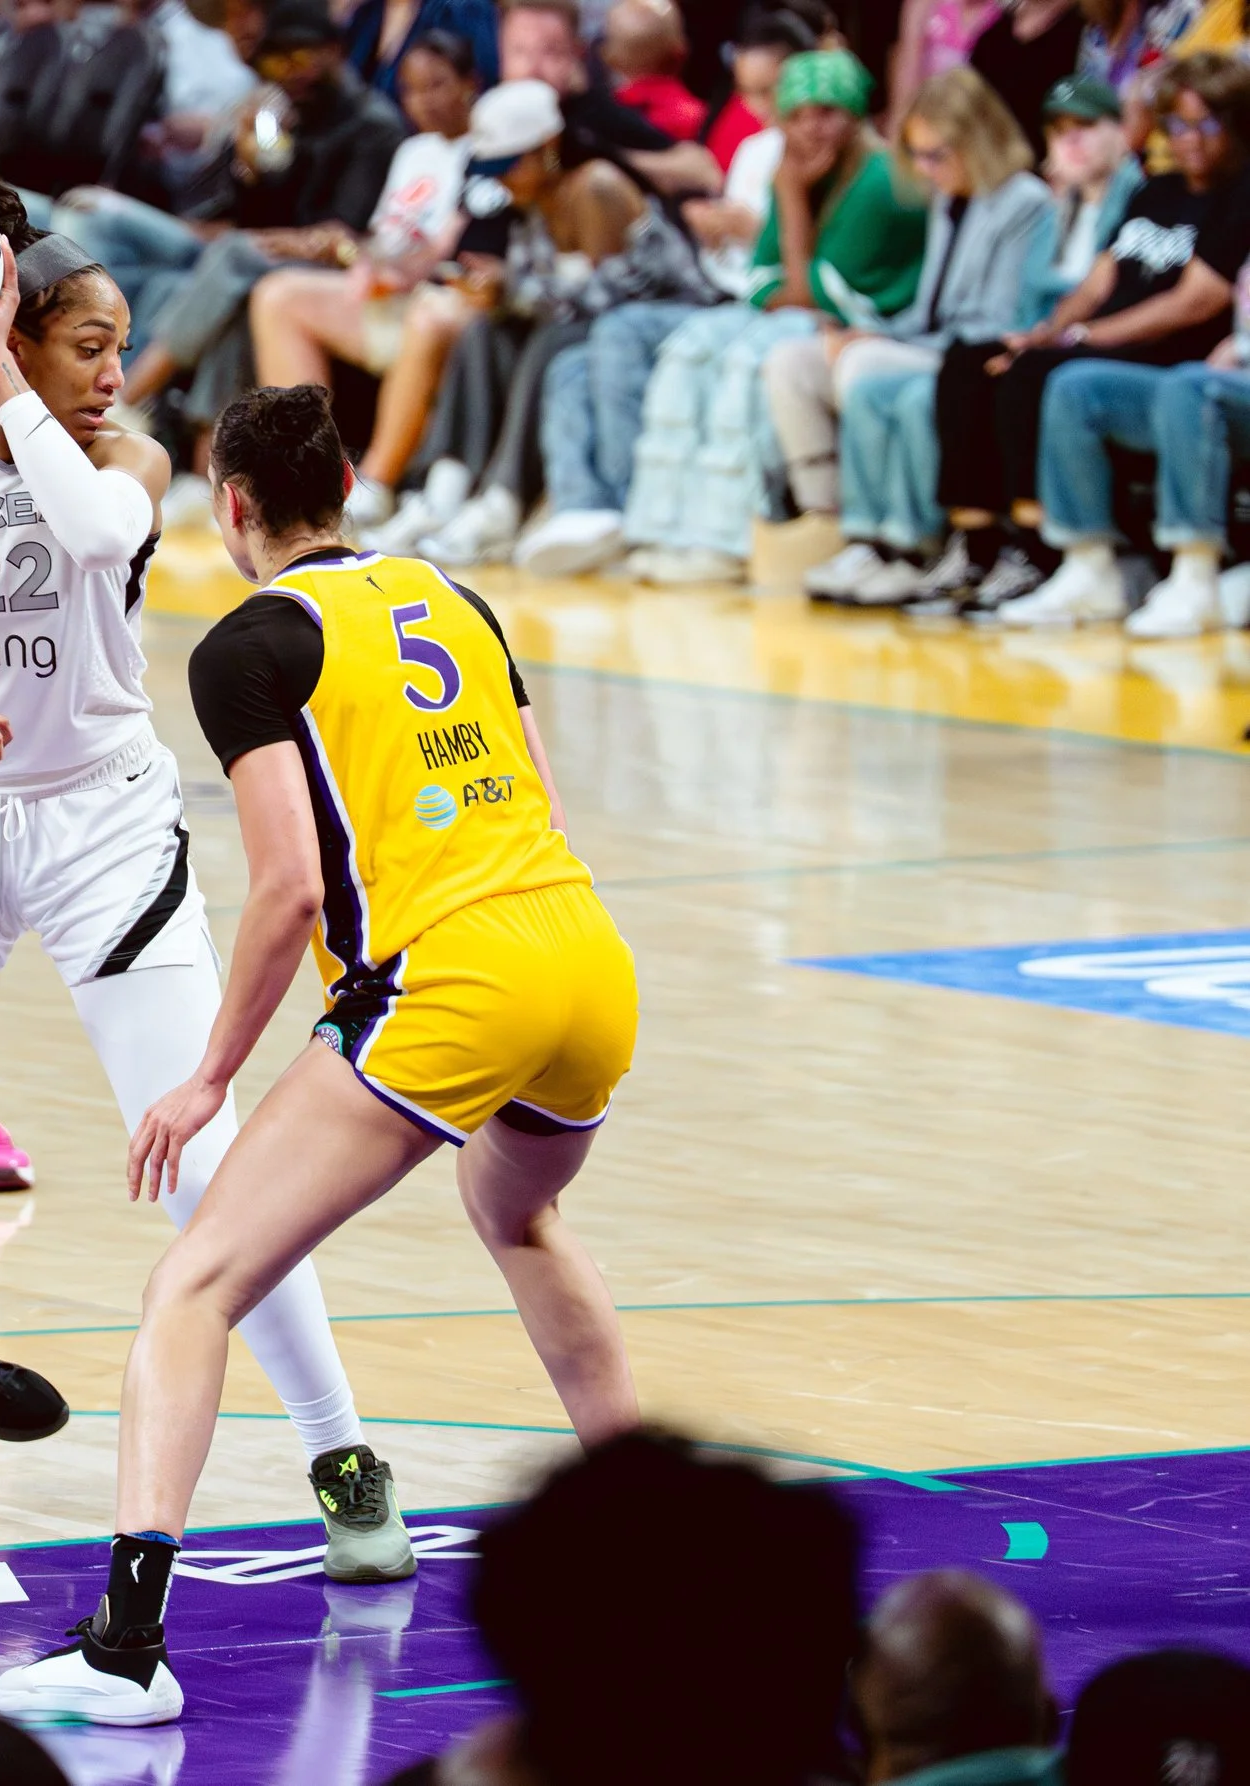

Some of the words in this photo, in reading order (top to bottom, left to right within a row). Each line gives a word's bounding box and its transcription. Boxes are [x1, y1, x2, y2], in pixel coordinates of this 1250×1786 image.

[390, 599, 463, 713] 5
[417, 720, 491, 770] HAMBY
[462, 776, 515, 807] AT&T
